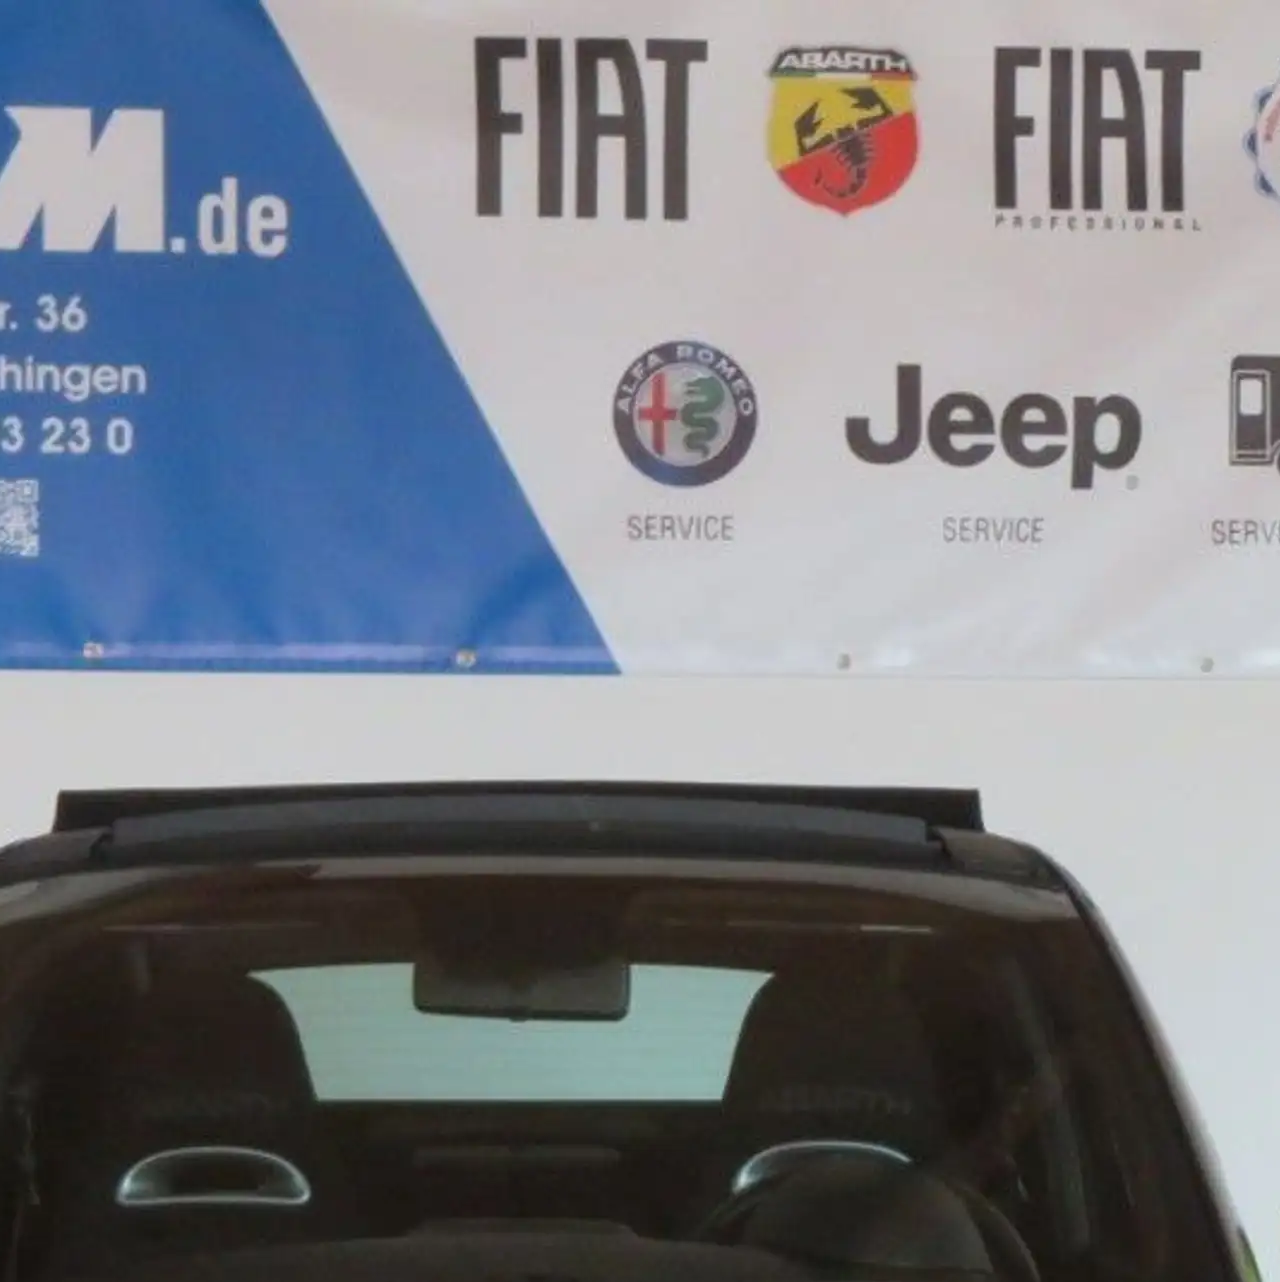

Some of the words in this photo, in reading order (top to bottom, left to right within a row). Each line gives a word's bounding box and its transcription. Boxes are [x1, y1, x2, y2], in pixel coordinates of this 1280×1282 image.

[780, 50, 906, 72] ABARTH
[475, 37, 708, 221] FIAT
[993, 46, 1201, 213] FIAT
[994, 212, 1202, 232] PROFESSIONAL
[36, 295, 88, 332] 36
[617, 351, 664, 415] ALFA
[676, 344, 754, 416] ROMEO
[40, 418, 92, 453] 23
[845, 364, 1142, 490] Jeep
[627, 514, 734, 542] SERVICE
[941, 515, 1045, 545] SERVICE
